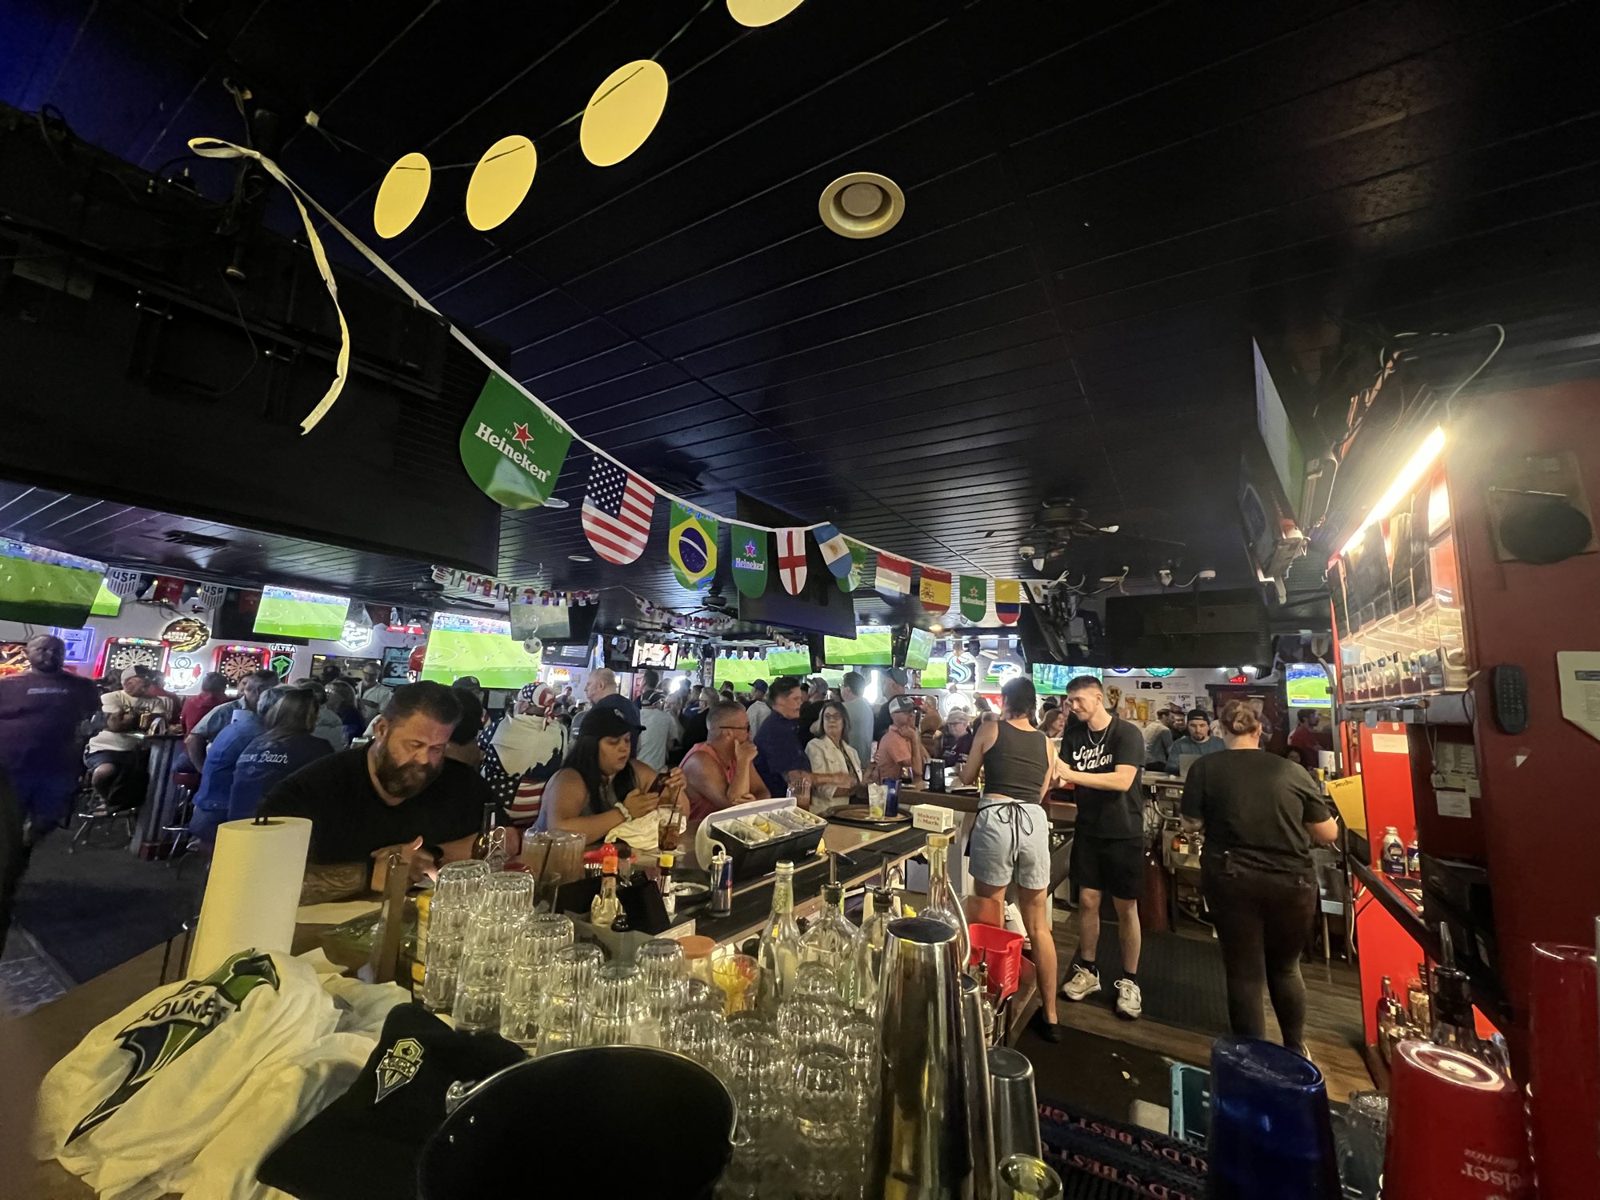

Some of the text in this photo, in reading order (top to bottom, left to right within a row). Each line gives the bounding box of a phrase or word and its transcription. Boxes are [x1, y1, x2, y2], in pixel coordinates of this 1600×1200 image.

[475, 421, 549, 483] Heineken
[735, 557, 765, 571] Heineken
[112, 571, 137, 583] USA
[203, 585, 224, 596] USA
[271, 643, 296, 653] ULTRA
